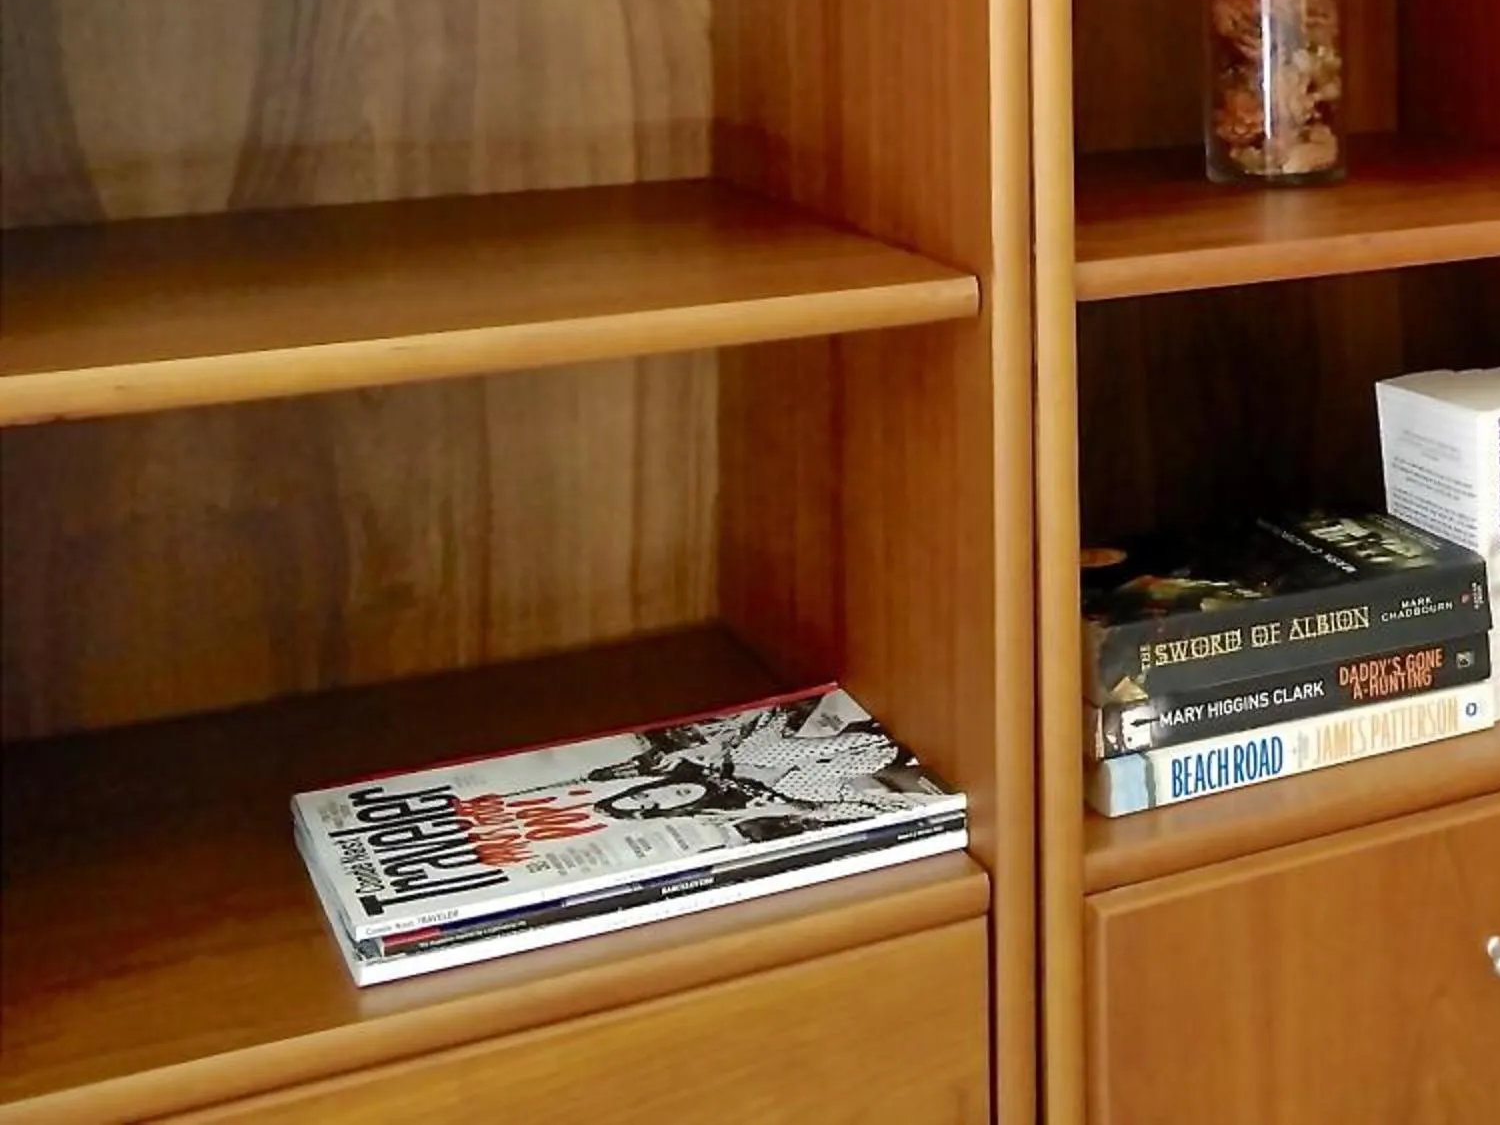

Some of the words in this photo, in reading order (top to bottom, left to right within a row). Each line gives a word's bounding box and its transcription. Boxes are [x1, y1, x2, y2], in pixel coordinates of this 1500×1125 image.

[1380, 601, 1453, 623] CHADBOURN
[1401, 596, 1433, 609] MARK
[1154, 628, 1243, 666] SWORD
[1251, 622, 1281, 648] OF
[1289, 606, 1370, 641] ALBION
[1339, 655, 1405, 686] DADDY'S
[1405, 648, 1444, 676] GONE
[1159, 704, 1205, 728] MARY
[1207, 691, 1270, 719] HIGGINS
[1272, 680, 1326, 706] CLARK
[1314, 717, 1368, 765] JAMES
[1370, 697, 1459, 752] PATTERSON
[1171, 747, 1230, 799] BEACH
[1233, 735, 1284, 785] ROAD
[328, 784, 510, 917] Traveler
